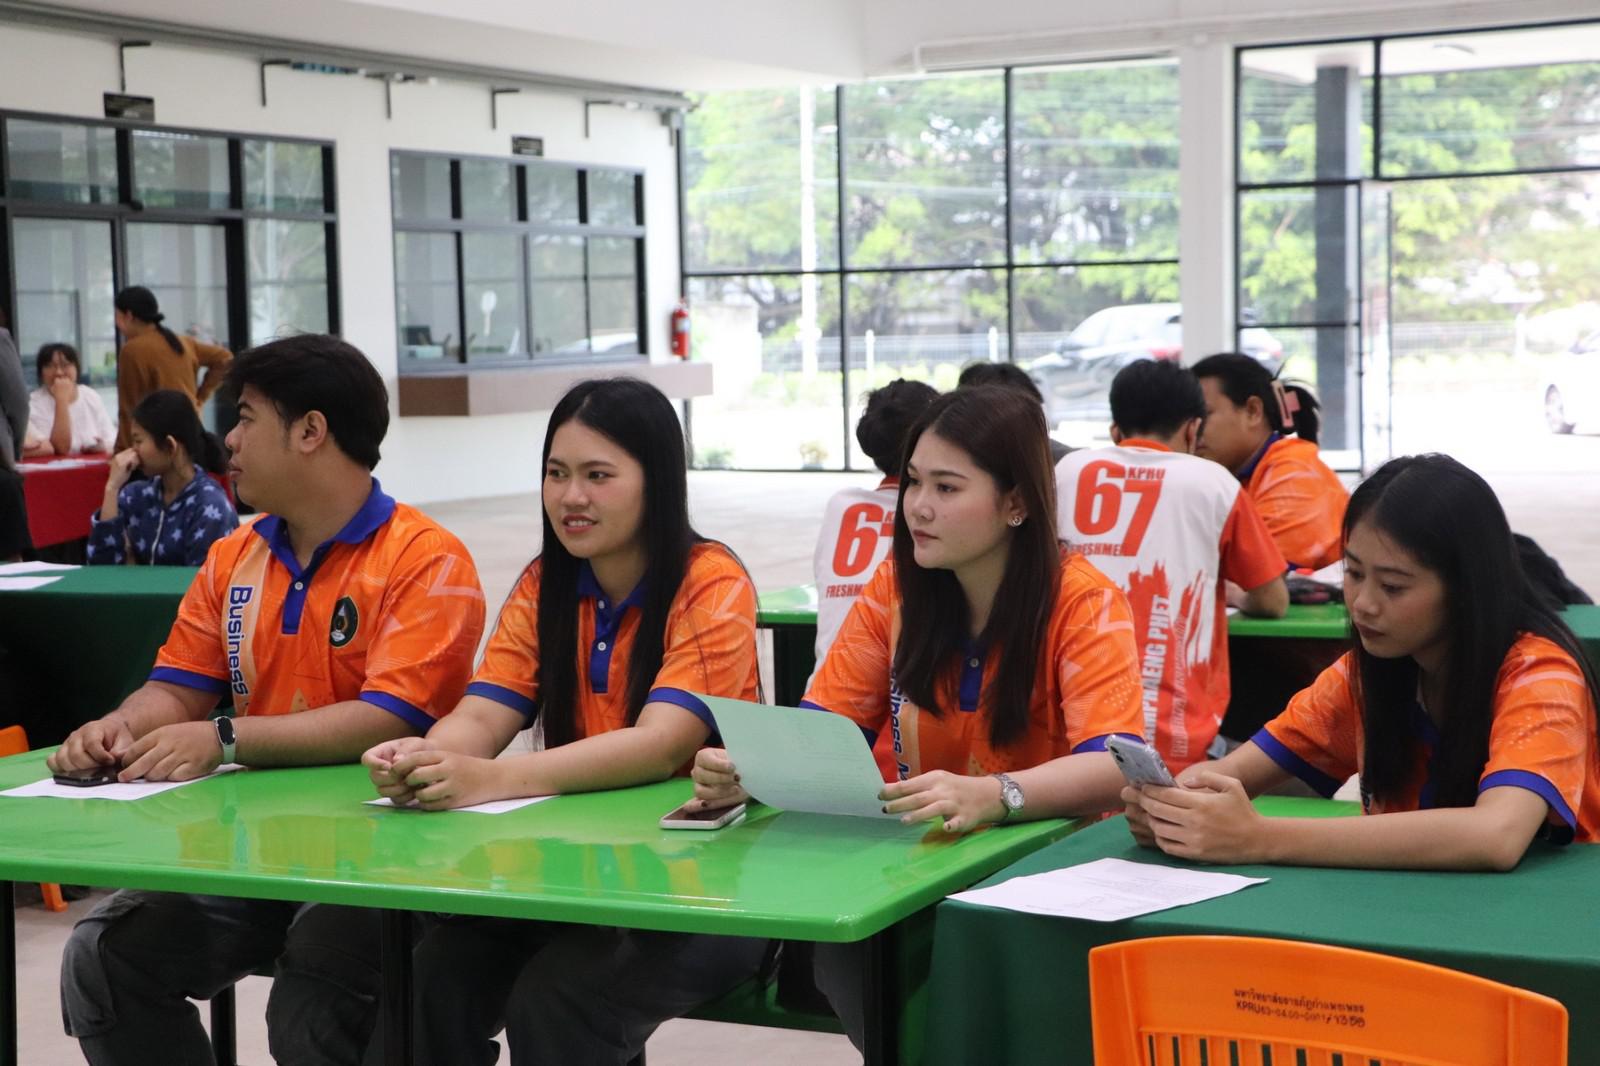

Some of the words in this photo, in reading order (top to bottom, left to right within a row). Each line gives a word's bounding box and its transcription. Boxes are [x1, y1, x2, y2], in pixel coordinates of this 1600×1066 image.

[1074, 459, 1162, 556] 67
[1126, 466, 1165, 480] KPRU
[228, 586, 253, 695] Business
[1148, 594, 1169, 640] PHET
